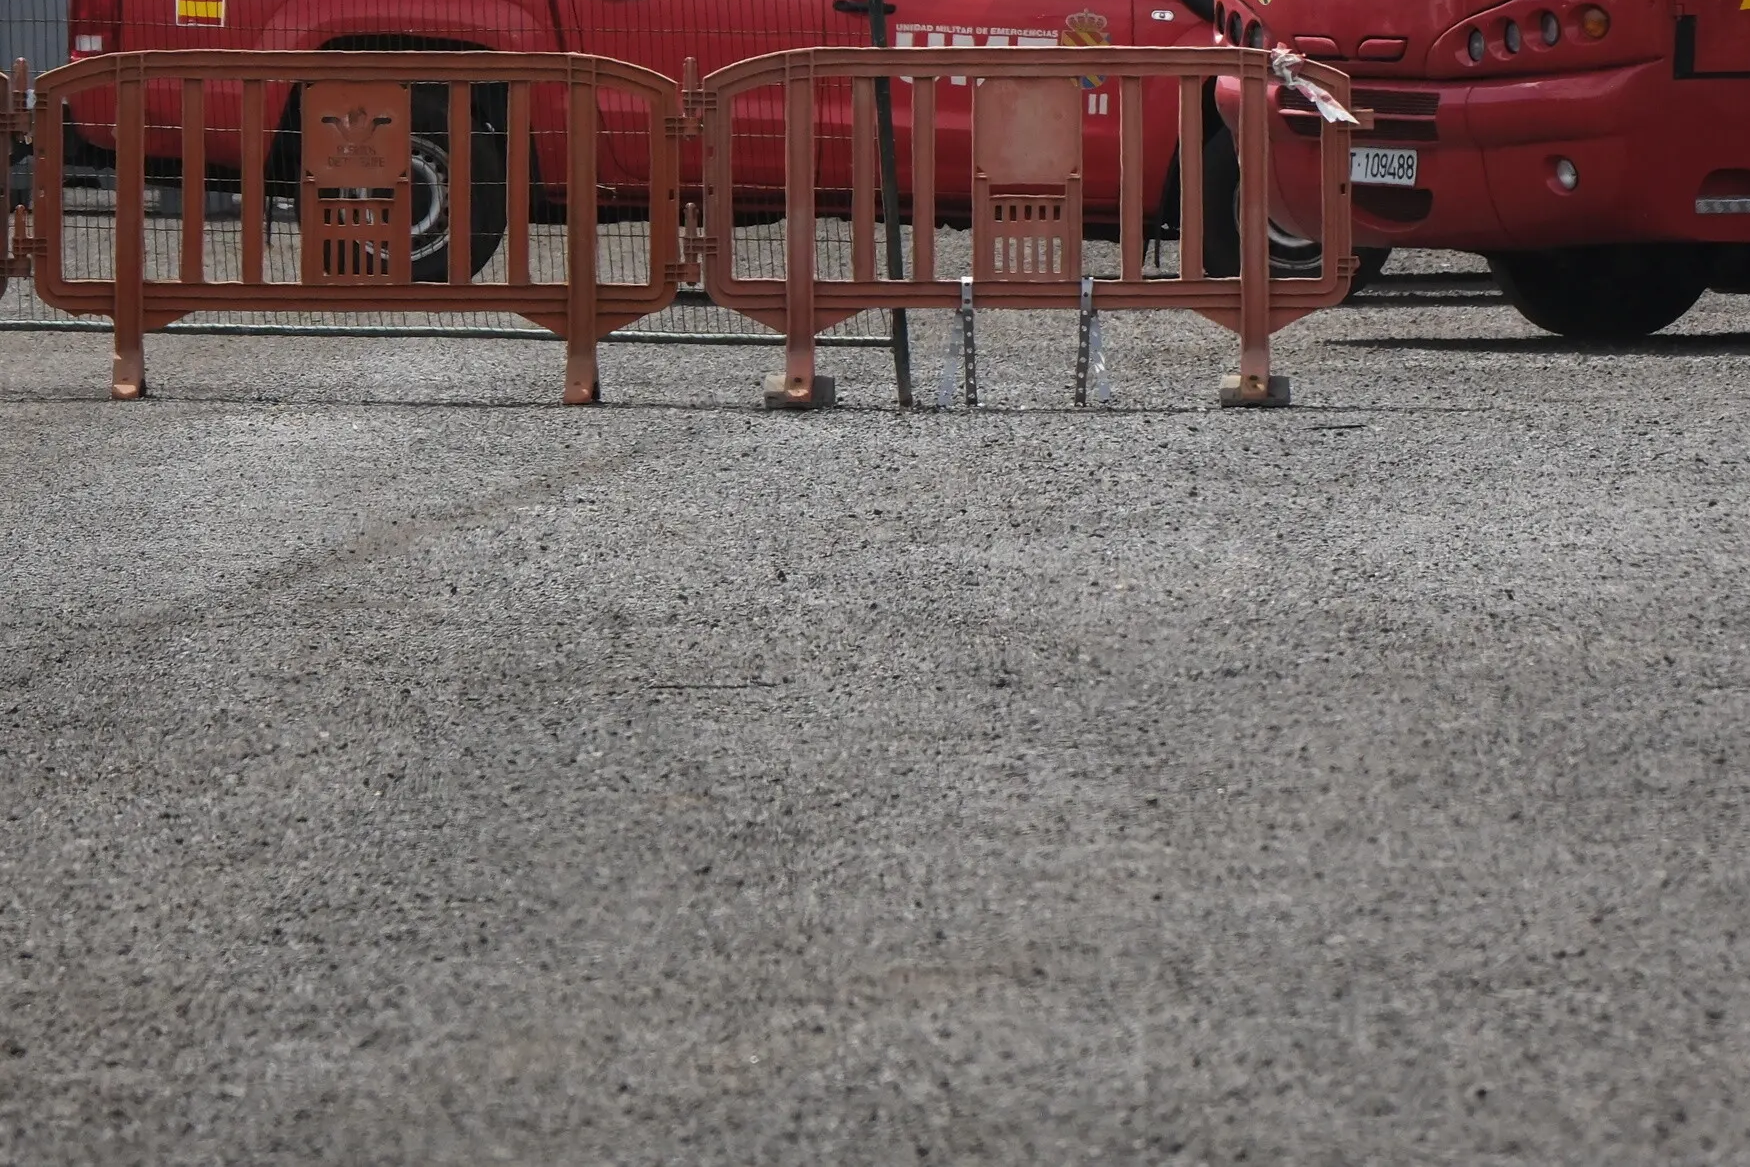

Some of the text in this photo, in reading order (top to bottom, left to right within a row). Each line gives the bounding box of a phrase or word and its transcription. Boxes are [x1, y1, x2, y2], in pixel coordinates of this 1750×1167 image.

[896, 23, 1059, 38] UNIDAD MILITAR DE EMERGENCIAS
